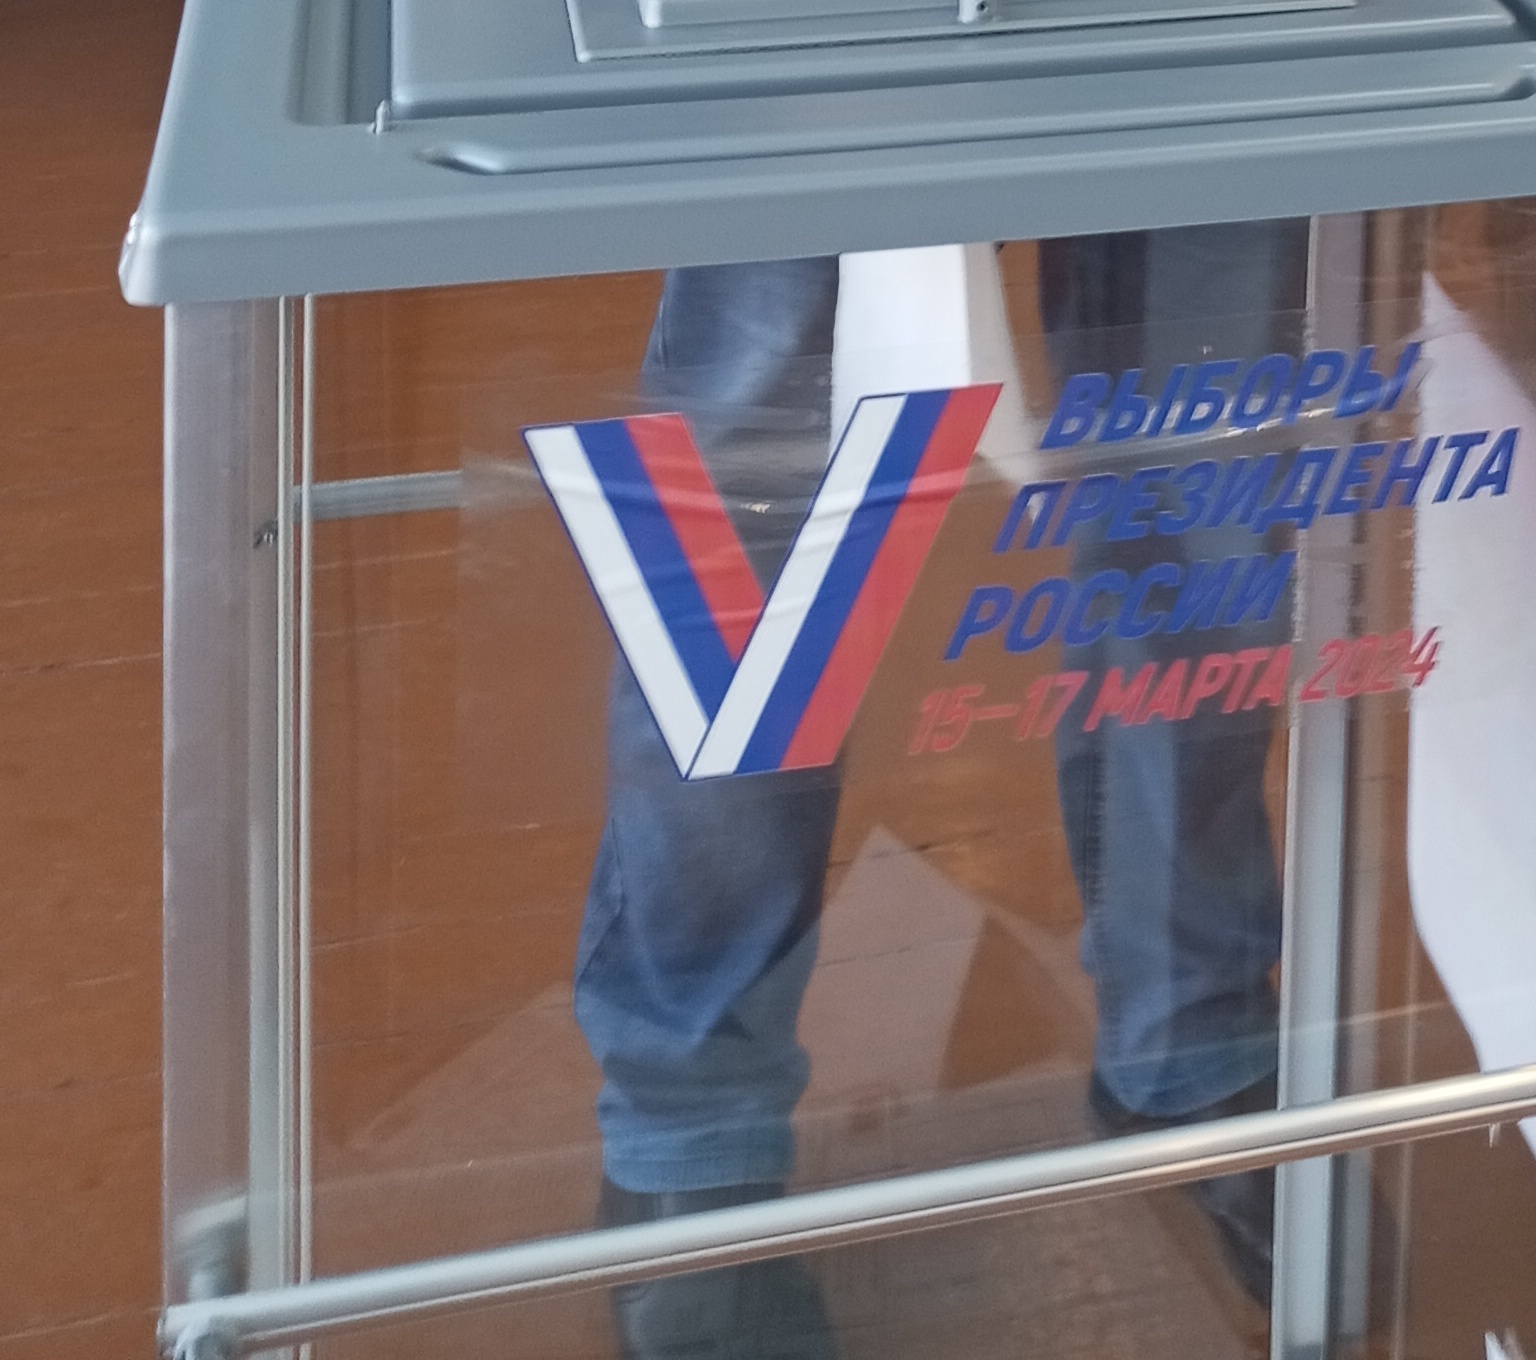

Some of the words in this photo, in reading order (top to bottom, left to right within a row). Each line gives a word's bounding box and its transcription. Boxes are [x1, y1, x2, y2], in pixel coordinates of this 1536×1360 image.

[1041, 341, 1424, 450] ВЫБОРЫ
[993, 427, 1521, 554] ПРЕЗИДЕНТА
[944, 550, 1298, 661] РОССИИ
[1084, 644, 1293, 732] МАРТА
[1298, 626, 1441, 704] 2024
